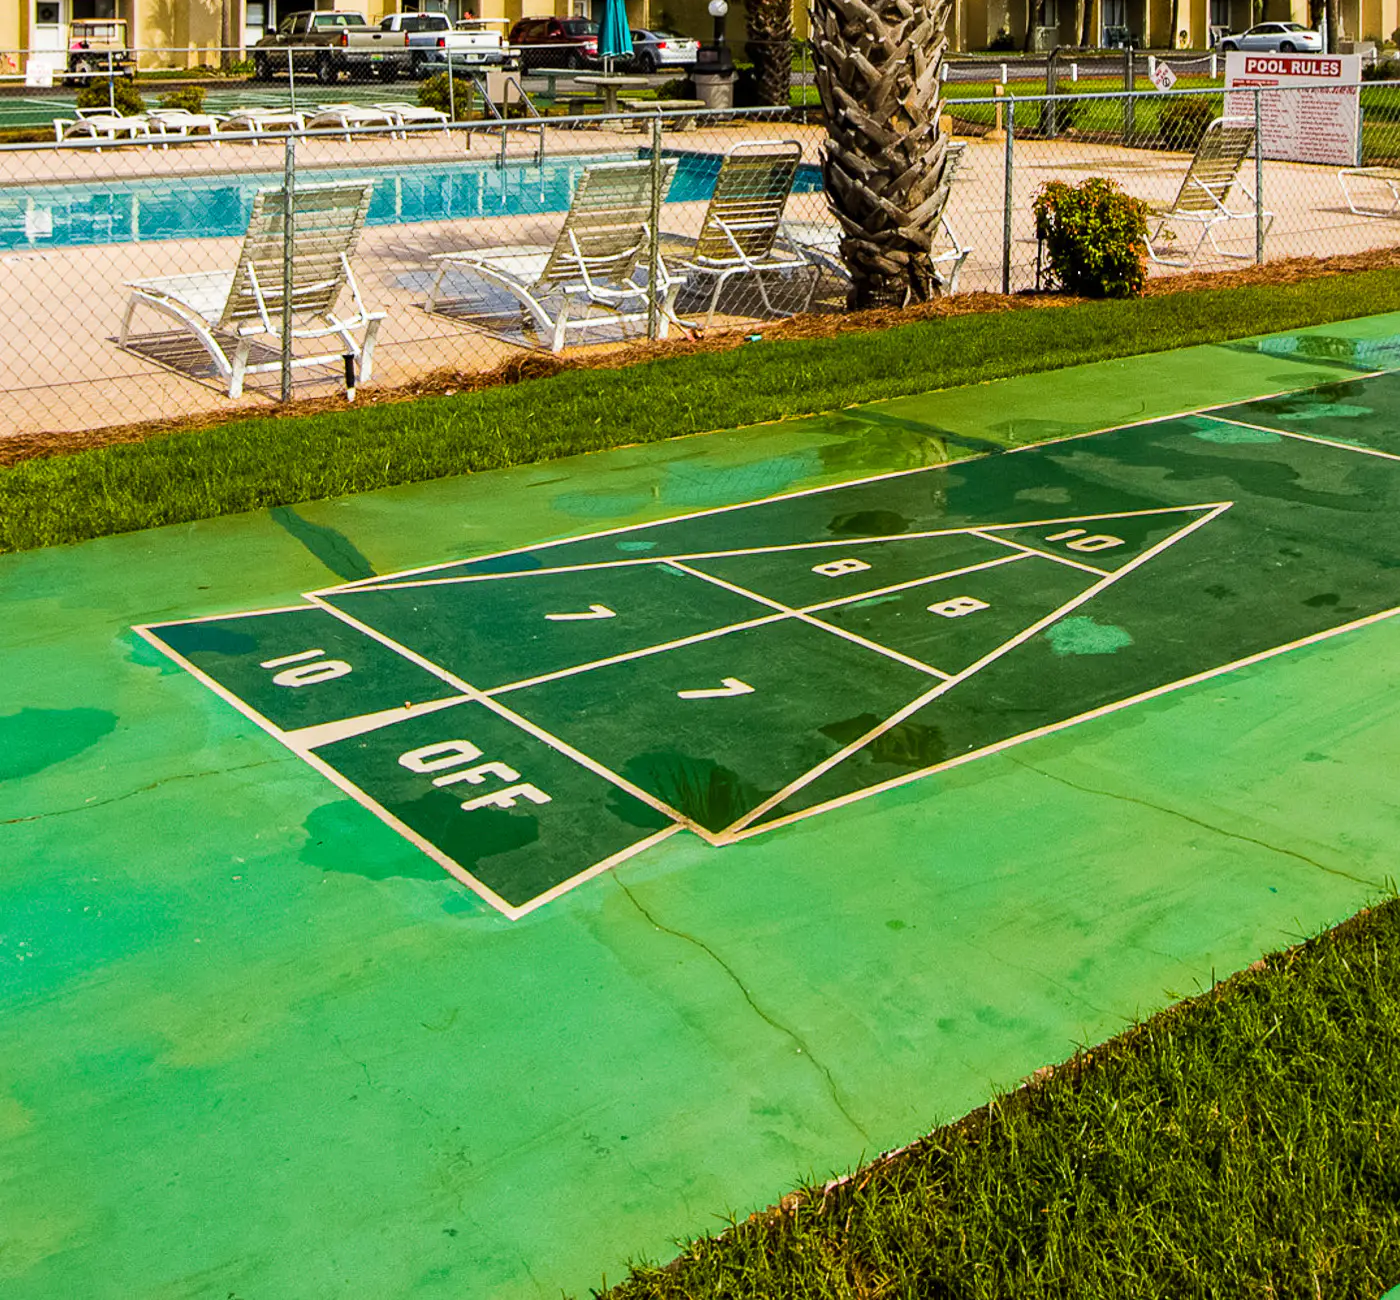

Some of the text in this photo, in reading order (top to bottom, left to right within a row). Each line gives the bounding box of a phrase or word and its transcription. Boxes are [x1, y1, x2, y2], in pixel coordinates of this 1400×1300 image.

[1247, 59, 1339, 75] POOL RULES
[1044, 528, 1125, 553] 10
[812, 558, 871, 578] 8
[544, 604, 617, 622] 7
[927, 595, 991, 618] 8
[677, 677, 756, 699] 7
[260, 648, 553, 811] 10 OFF
